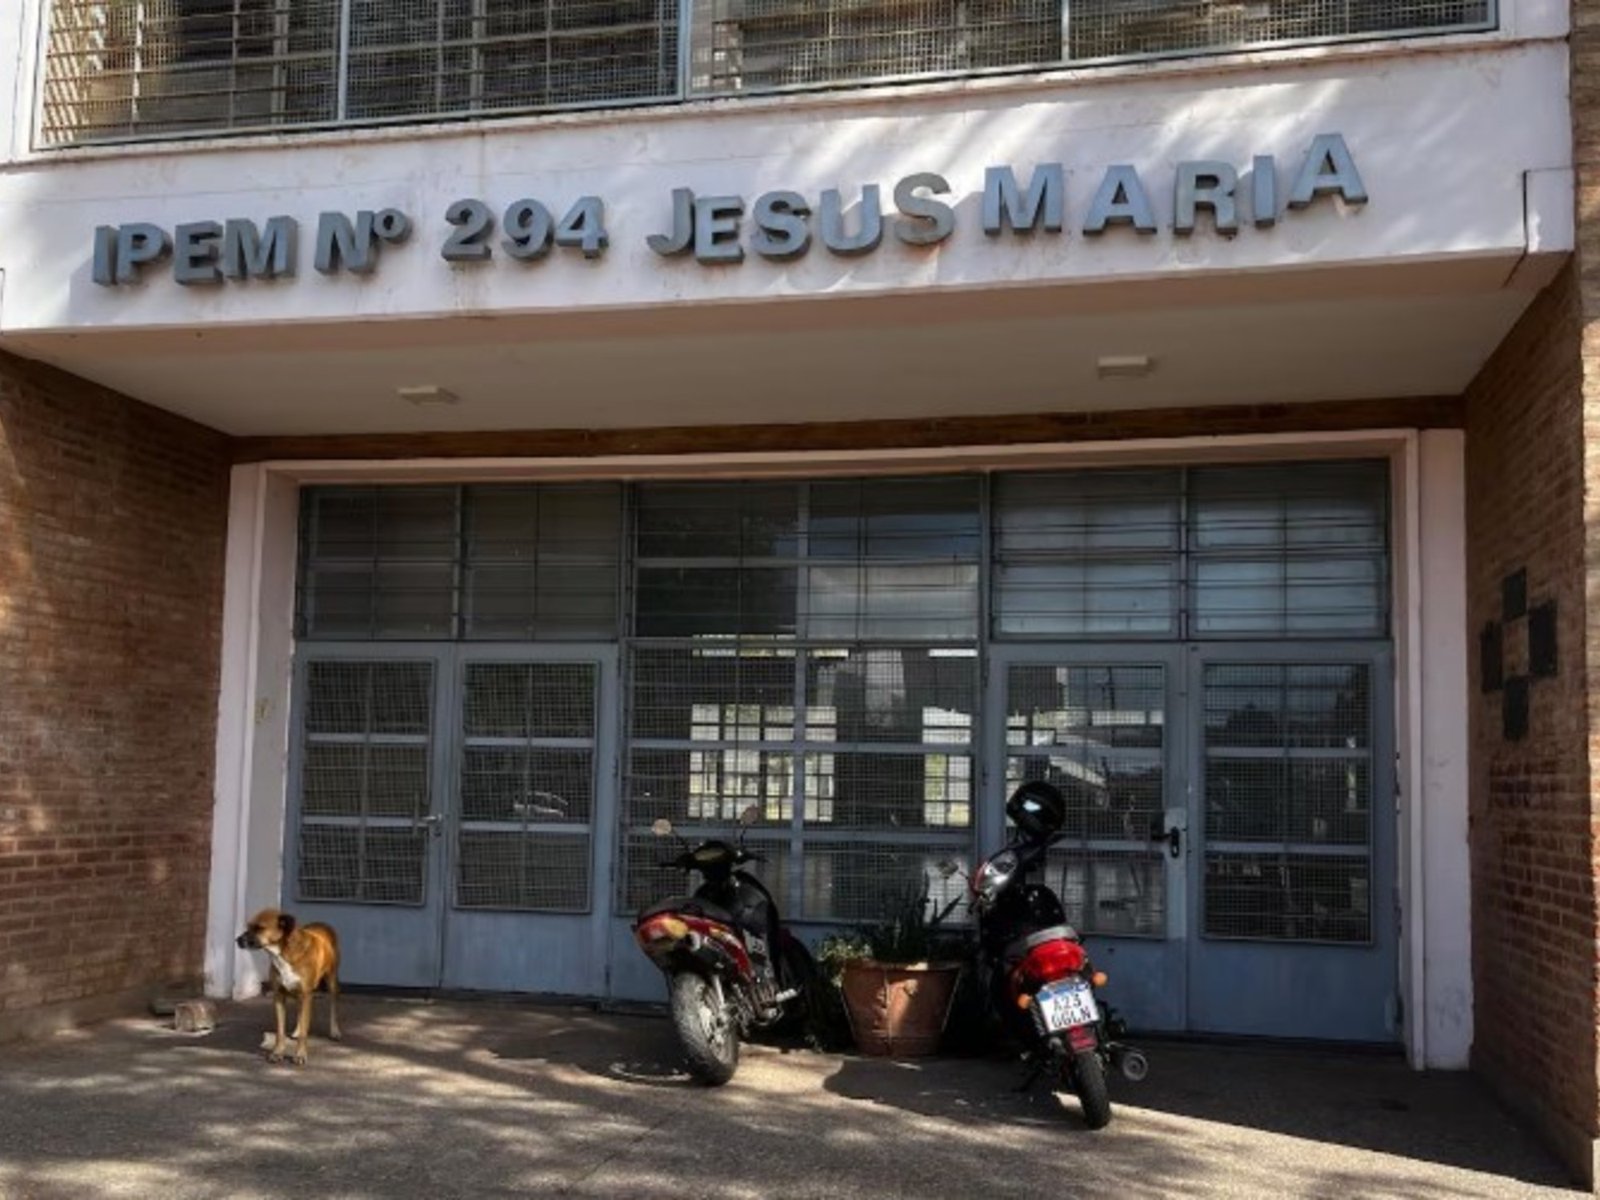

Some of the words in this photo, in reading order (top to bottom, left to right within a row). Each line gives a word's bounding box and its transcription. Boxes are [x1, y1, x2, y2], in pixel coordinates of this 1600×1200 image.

[92, 215, 298, 284] IPEM
[441, 196, 608, 261] 294
[646, 172, 955, 264] JESUS
[983, 133, 1369, 237] MARIA
